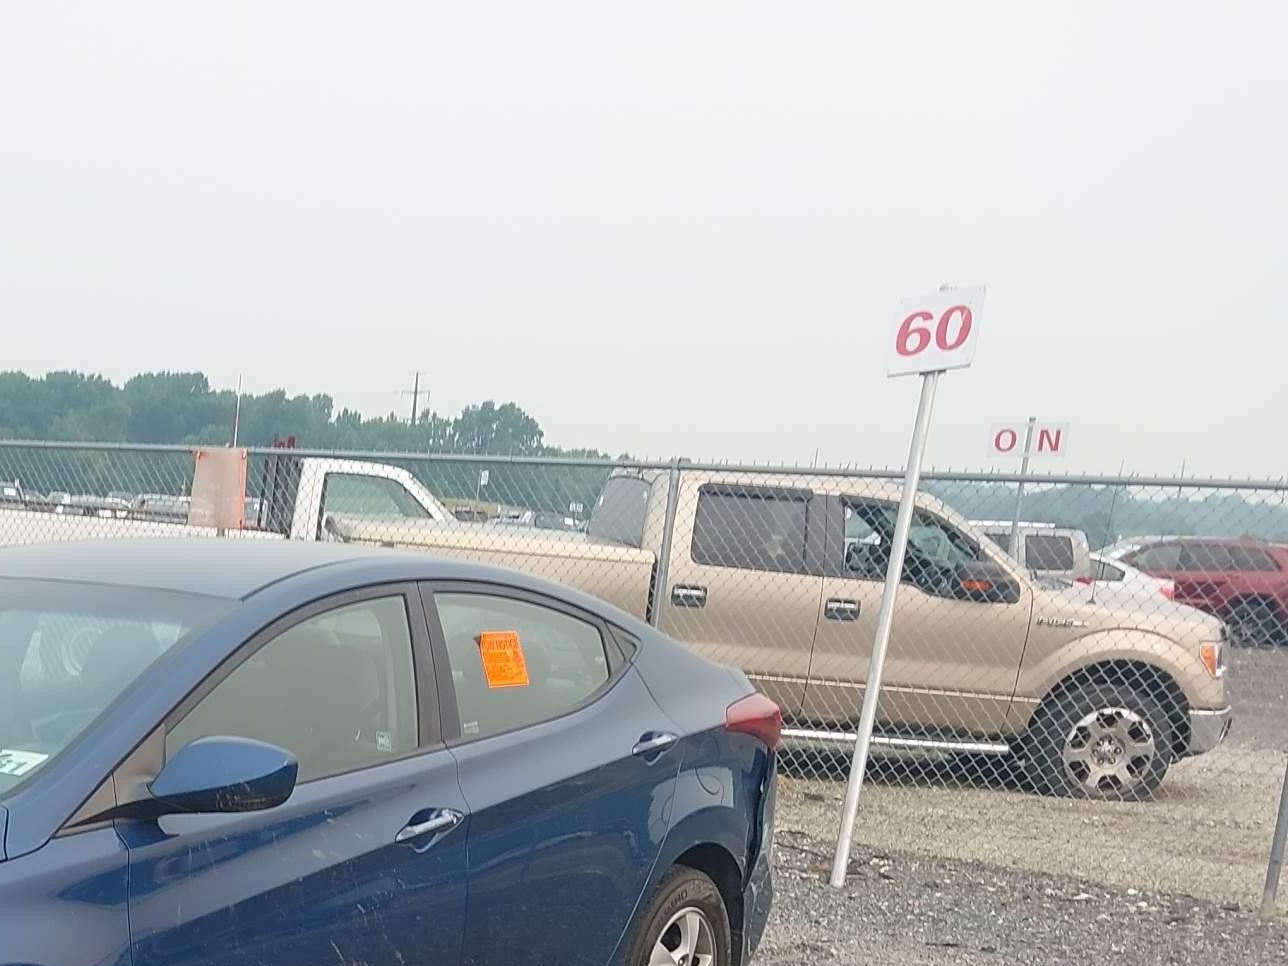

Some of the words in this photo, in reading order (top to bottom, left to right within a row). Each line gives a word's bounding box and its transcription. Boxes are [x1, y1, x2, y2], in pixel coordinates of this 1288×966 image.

[895, 304, 973, 357] 60
[993, 428, 1017, 452] O
[1037, 428, 1062, 452] N
